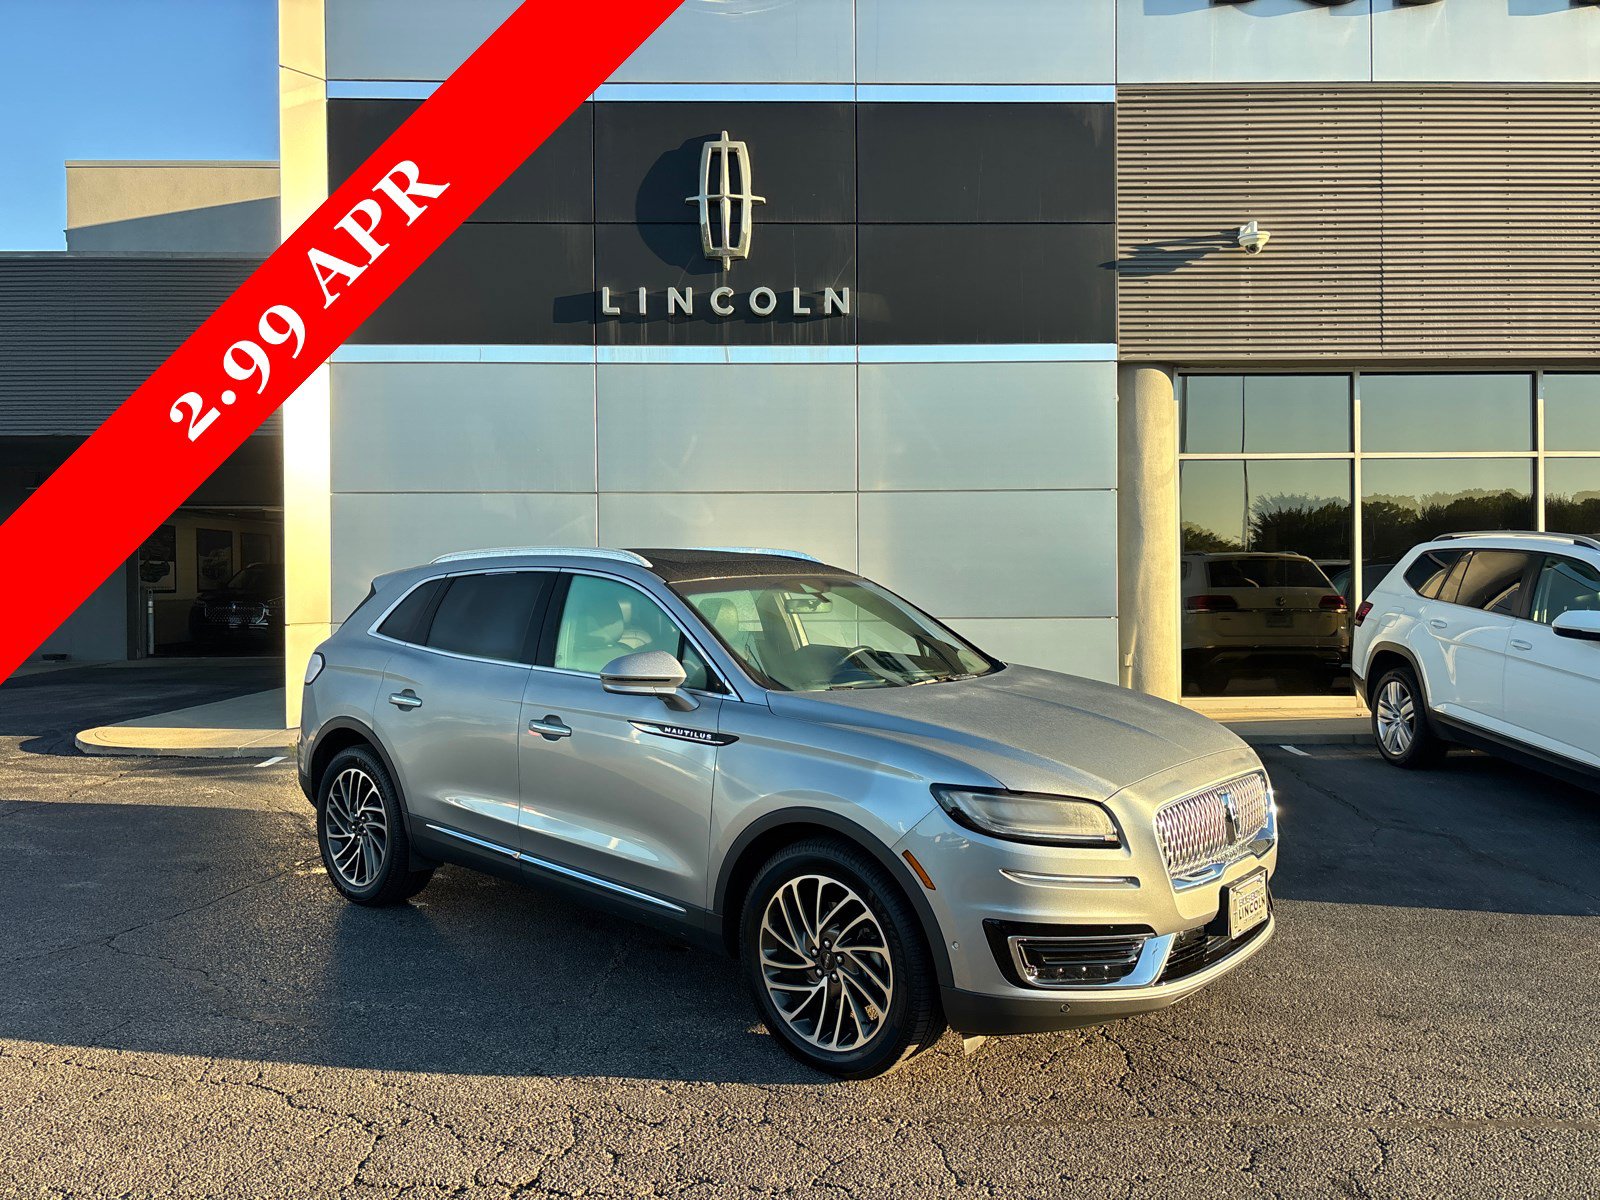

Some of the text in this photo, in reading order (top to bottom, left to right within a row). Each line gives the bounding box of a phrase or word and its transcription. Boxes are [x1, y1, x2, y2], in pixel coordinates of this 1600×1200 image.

[602, 286, 849, 316] LINCOLN
[664, 726, 712, 740] NAUTILUS
[1238, 895, 1265, 920] LINCOLN
